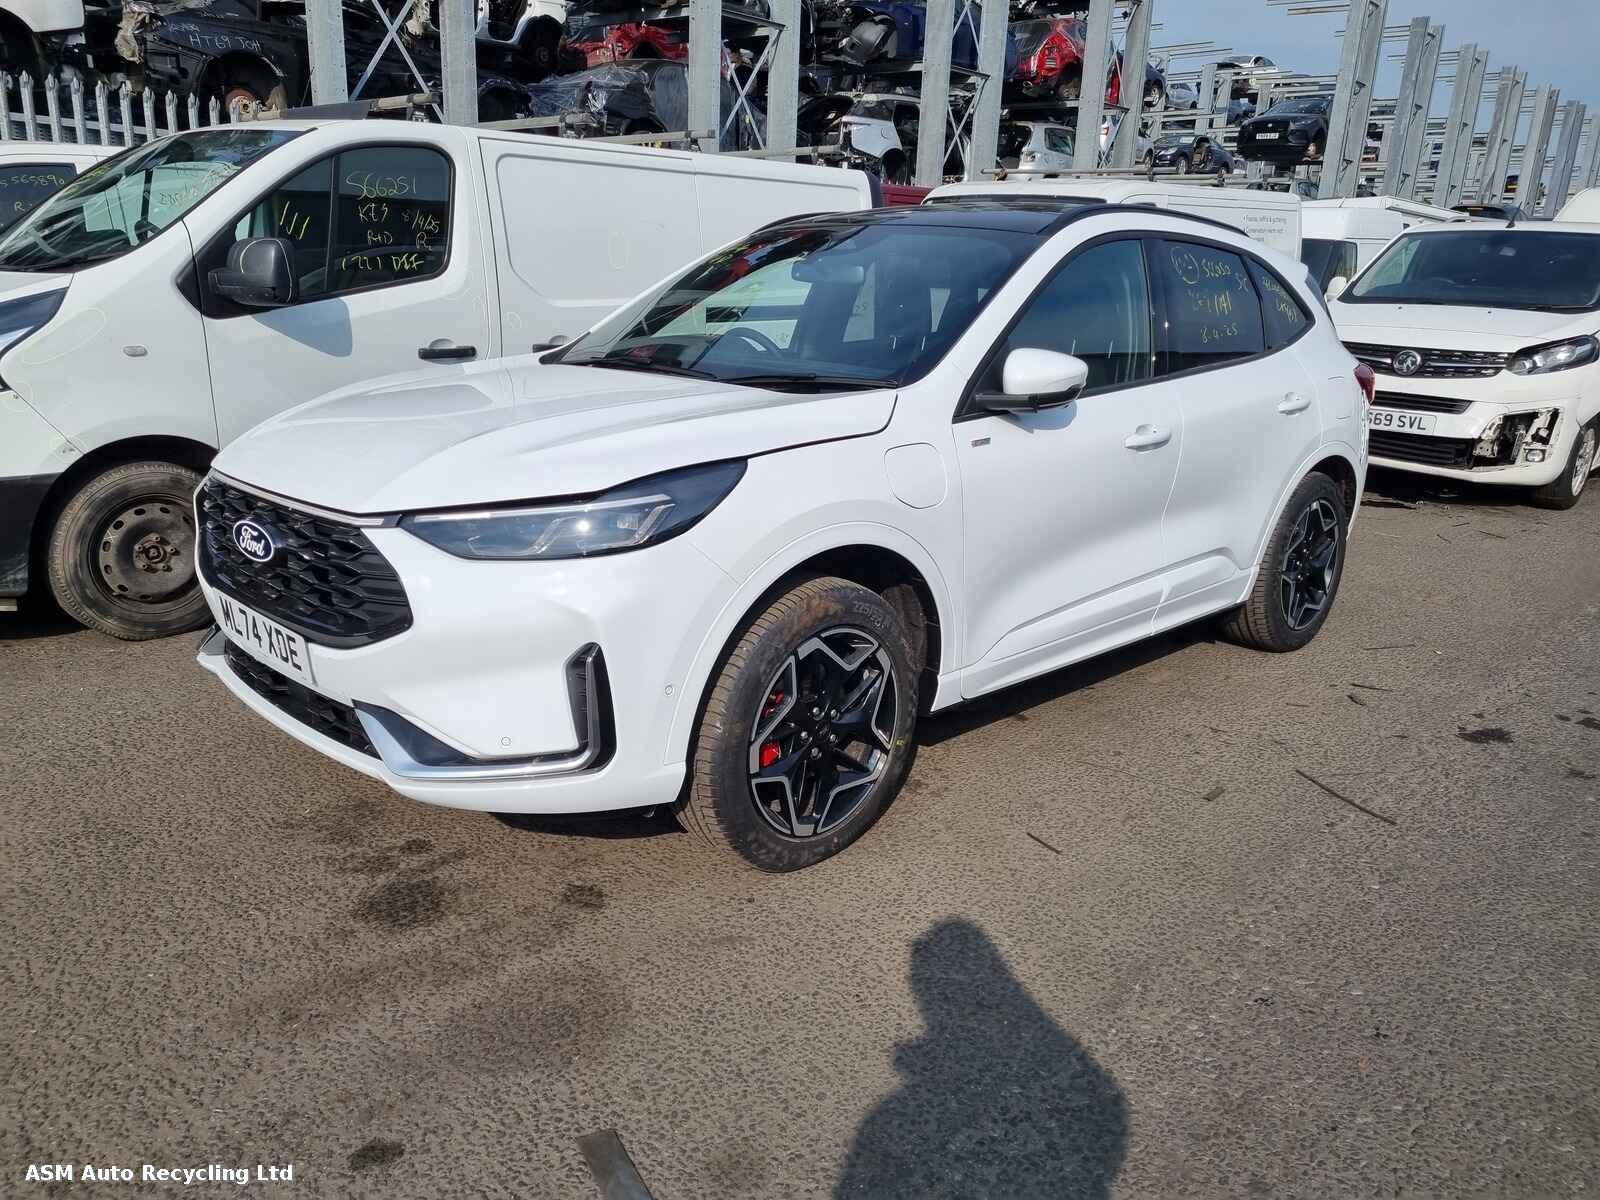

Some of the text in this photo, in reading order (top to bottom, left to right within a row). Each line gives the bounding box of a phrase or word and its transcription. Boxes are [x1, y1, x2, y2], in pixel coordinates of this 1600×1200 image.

[345, 171, 417, 201] 566251
[1396, 414, 1427, 431] SVL
[239, 525, 265, 557] Ford
[219, 595, 303, 673] ML74 XDE
